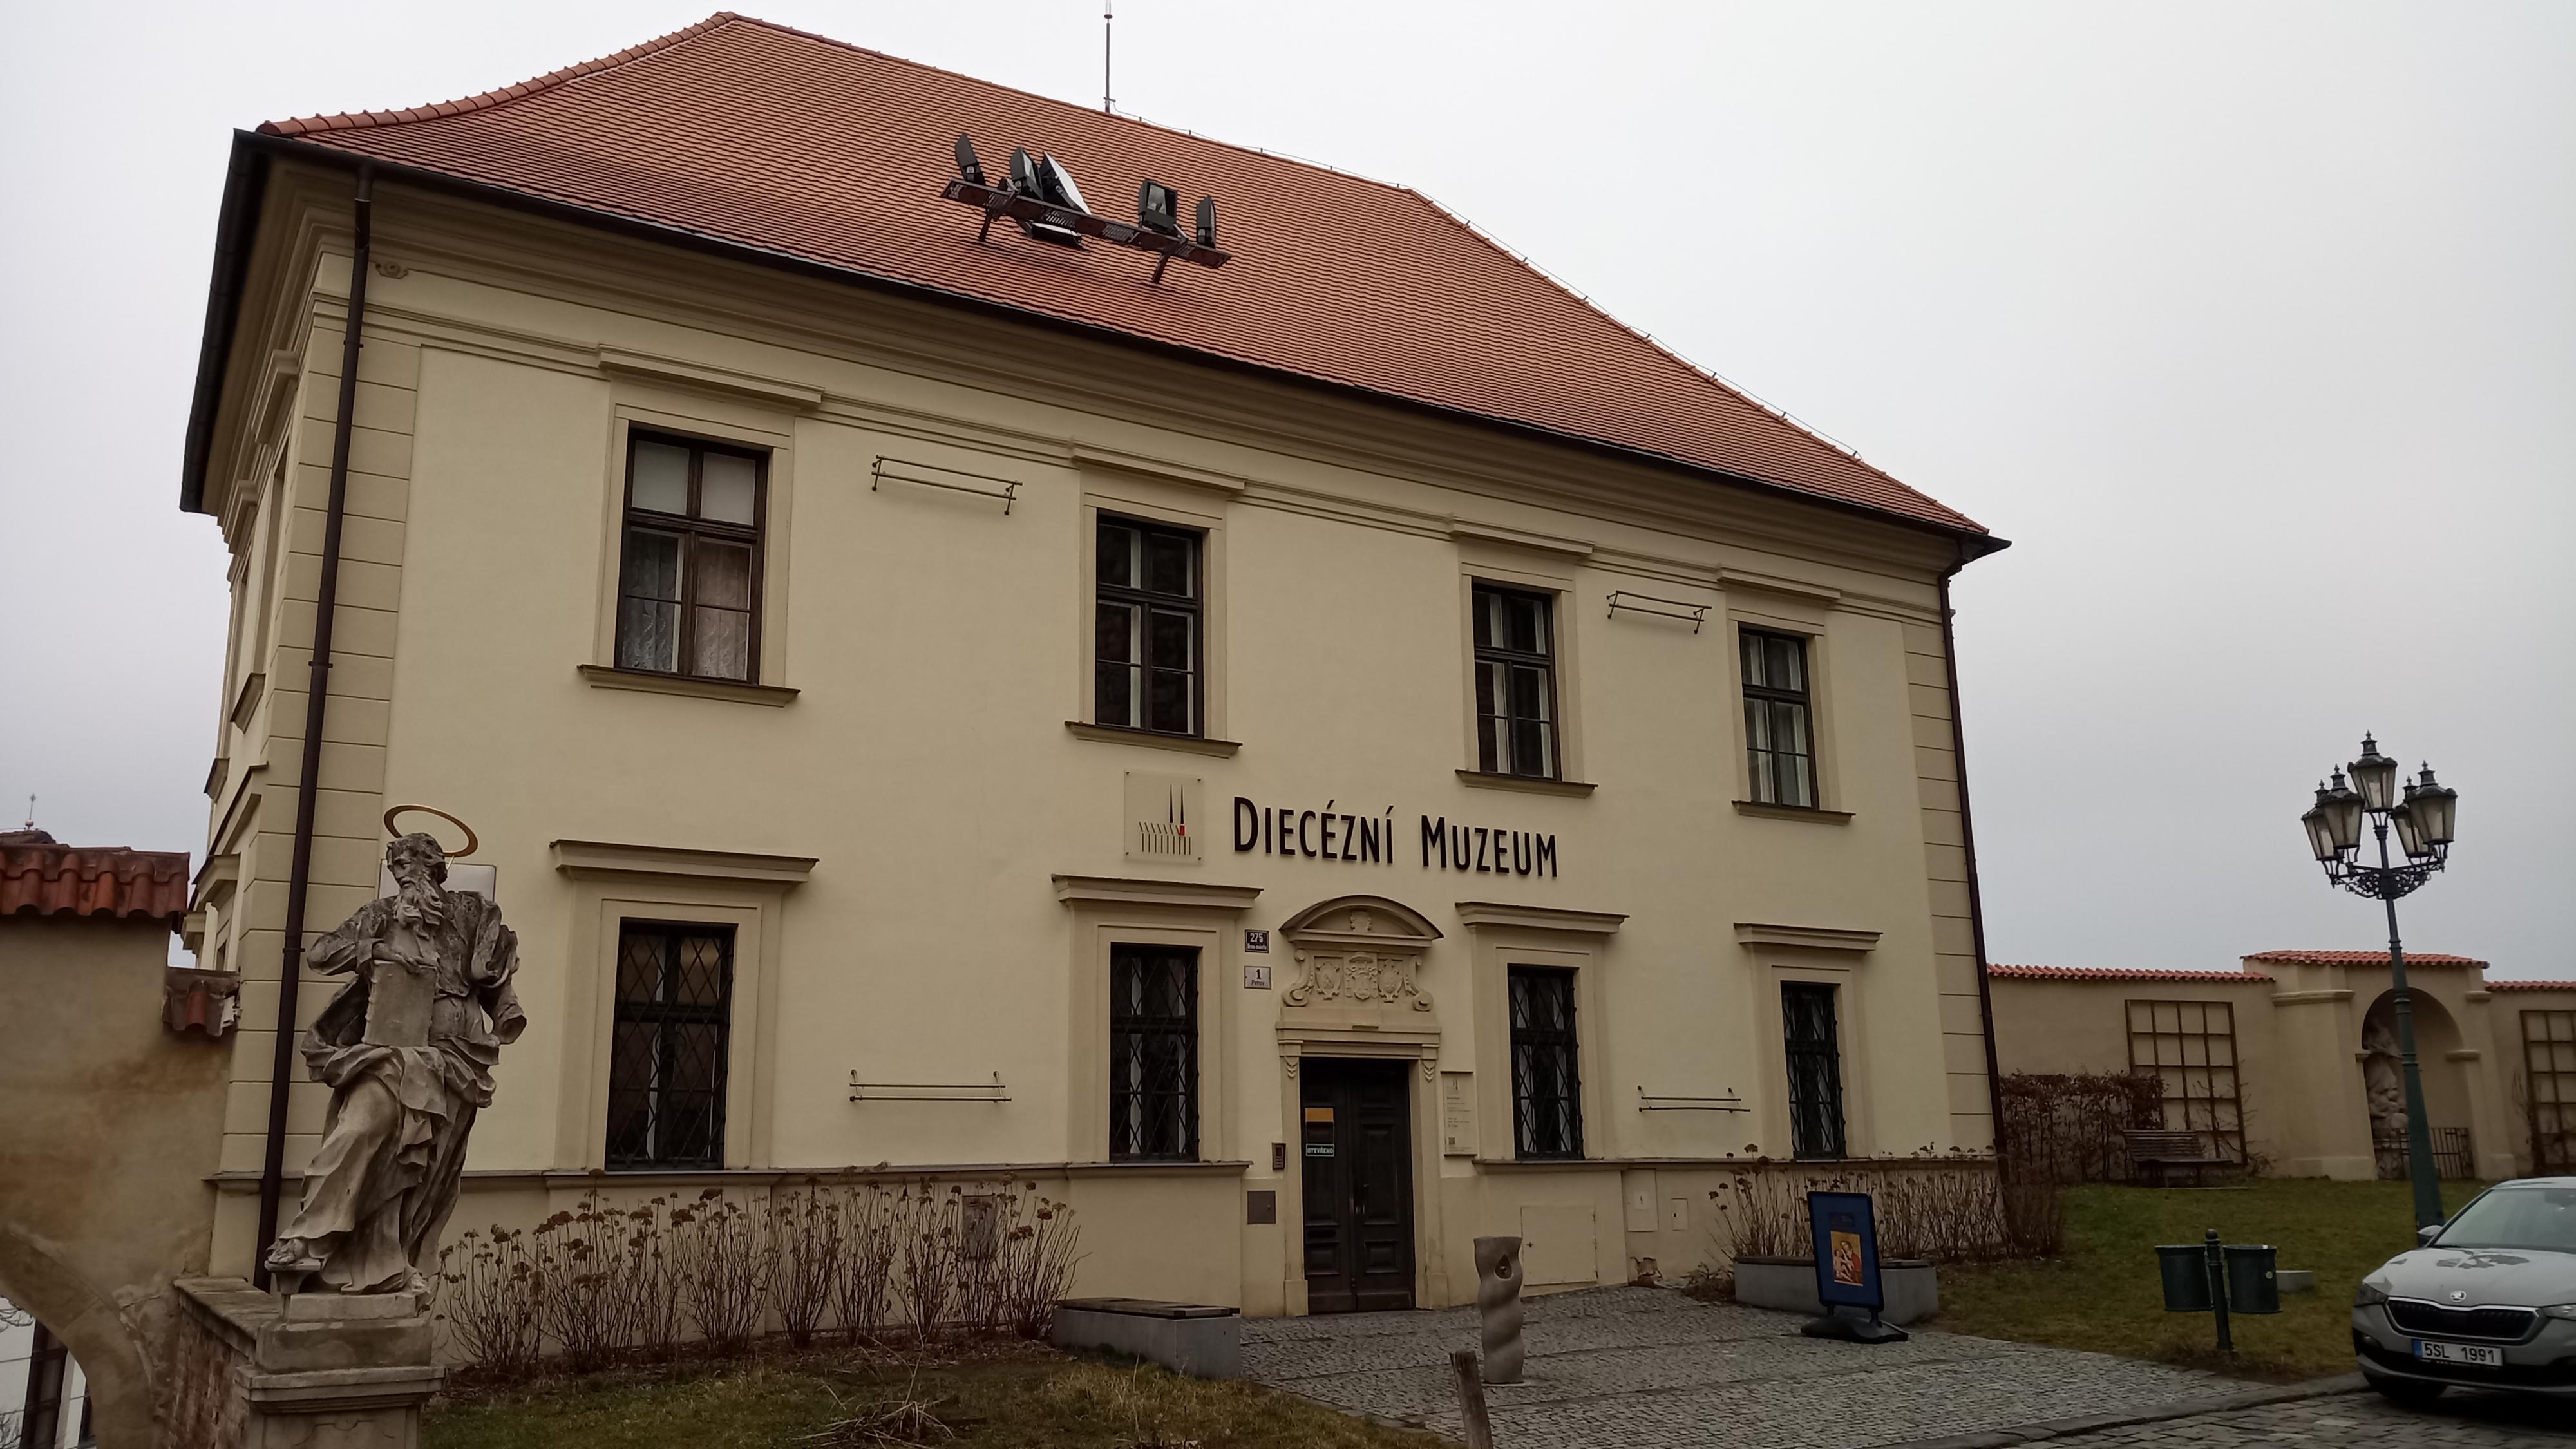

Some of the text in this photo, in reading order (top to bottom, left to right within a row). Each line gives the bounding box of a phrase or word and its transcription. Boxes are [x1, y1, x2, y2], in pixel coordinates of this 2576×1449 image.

[1233, 797, 1557, 878] DIECÉZNÍ MUZEUM
[1250, 933, 1264, 942] 275
[1256, 969, 1261, 979] 1
[2425, 1343, 2495, 1363] 5SL 1991
